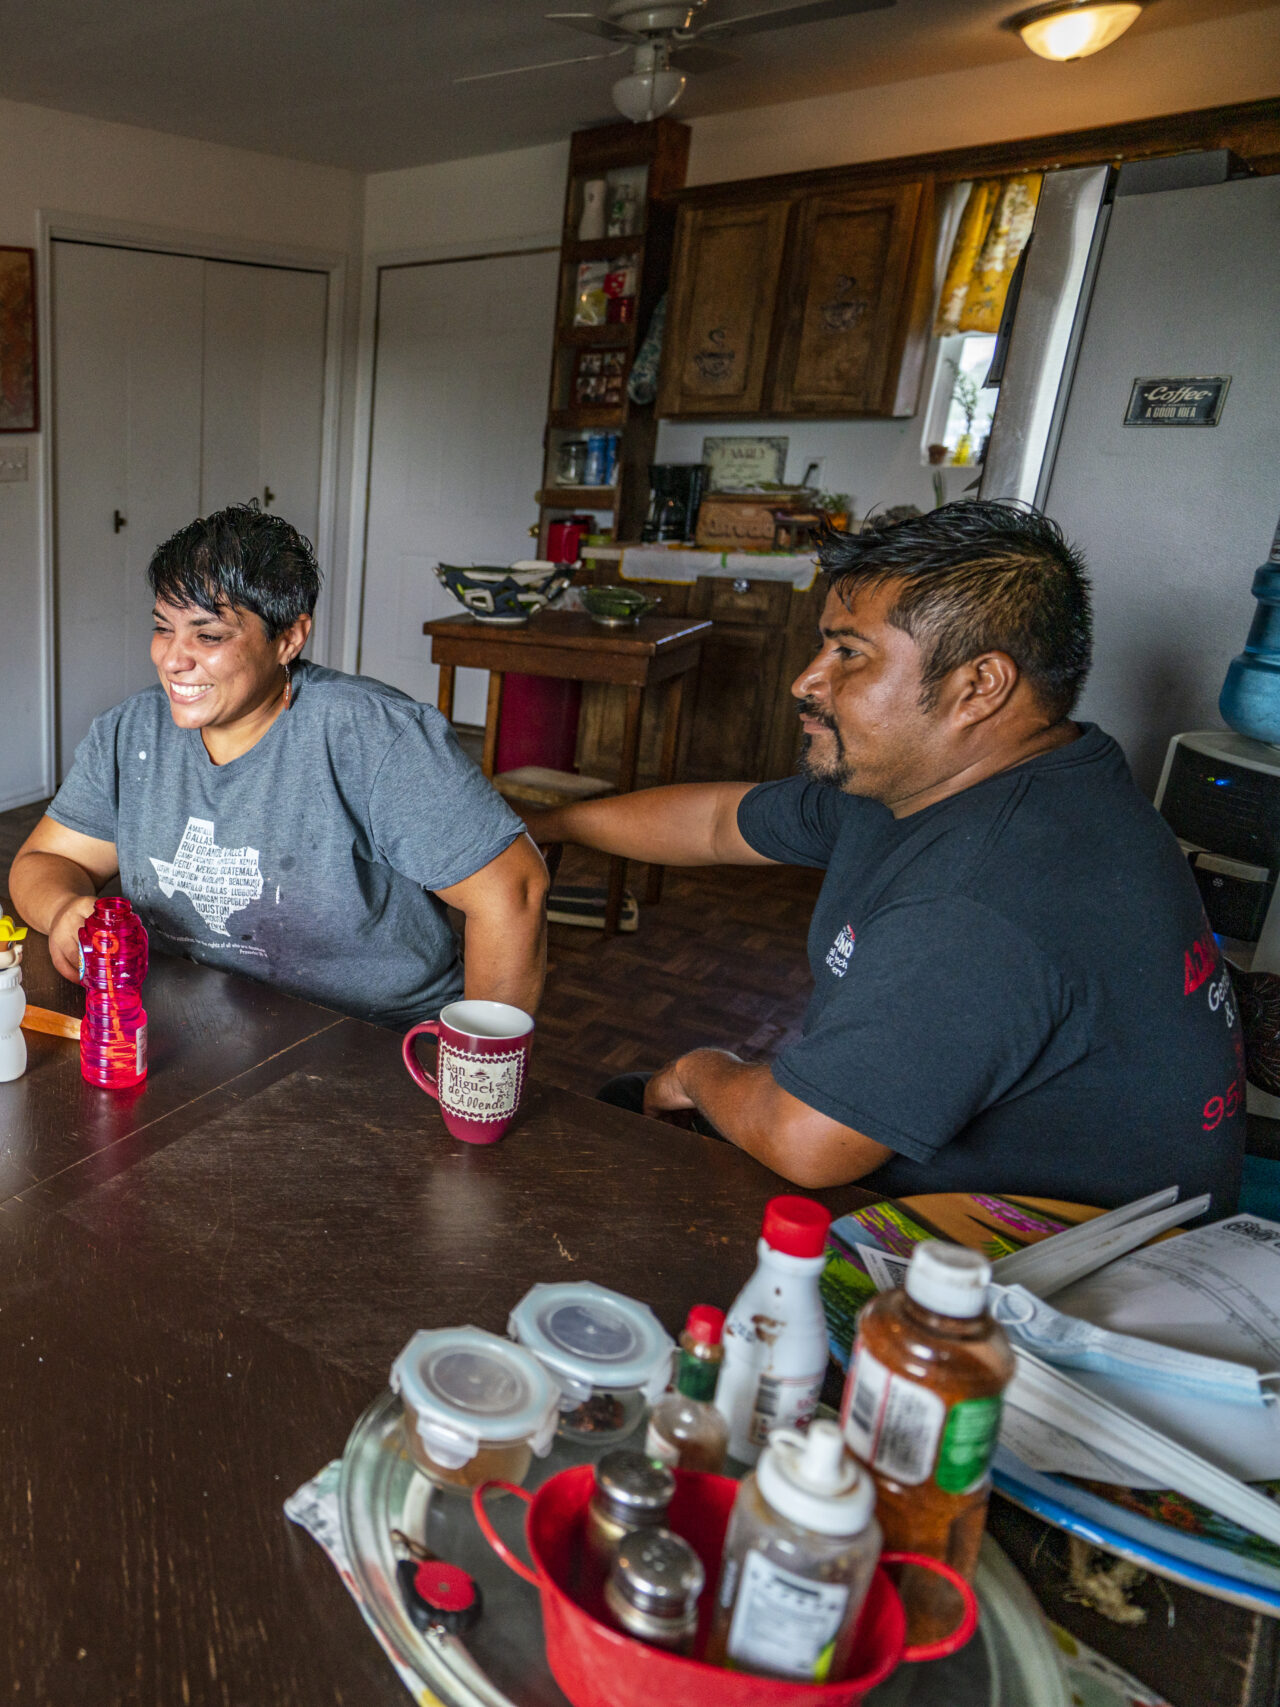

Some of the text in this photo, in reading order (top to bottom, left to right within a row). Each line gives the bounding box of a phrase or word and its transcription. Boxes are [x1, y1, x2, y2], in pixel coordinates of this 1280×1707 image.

[1147, 385, 1208, 404] Coffee
[1145, 407, 1152, 418] A
[185, 831, 214, 846] DALLAS
[180, 840, 195, 853] RIO
[195, 901, 230, 916] HOUSTON
[445, 1057, 466, 1076] San
[448, 1083, 460, 1096] de
[449, 1072, 494, 1095] Miguel
[450, 1095, 505, 1111] Allende
